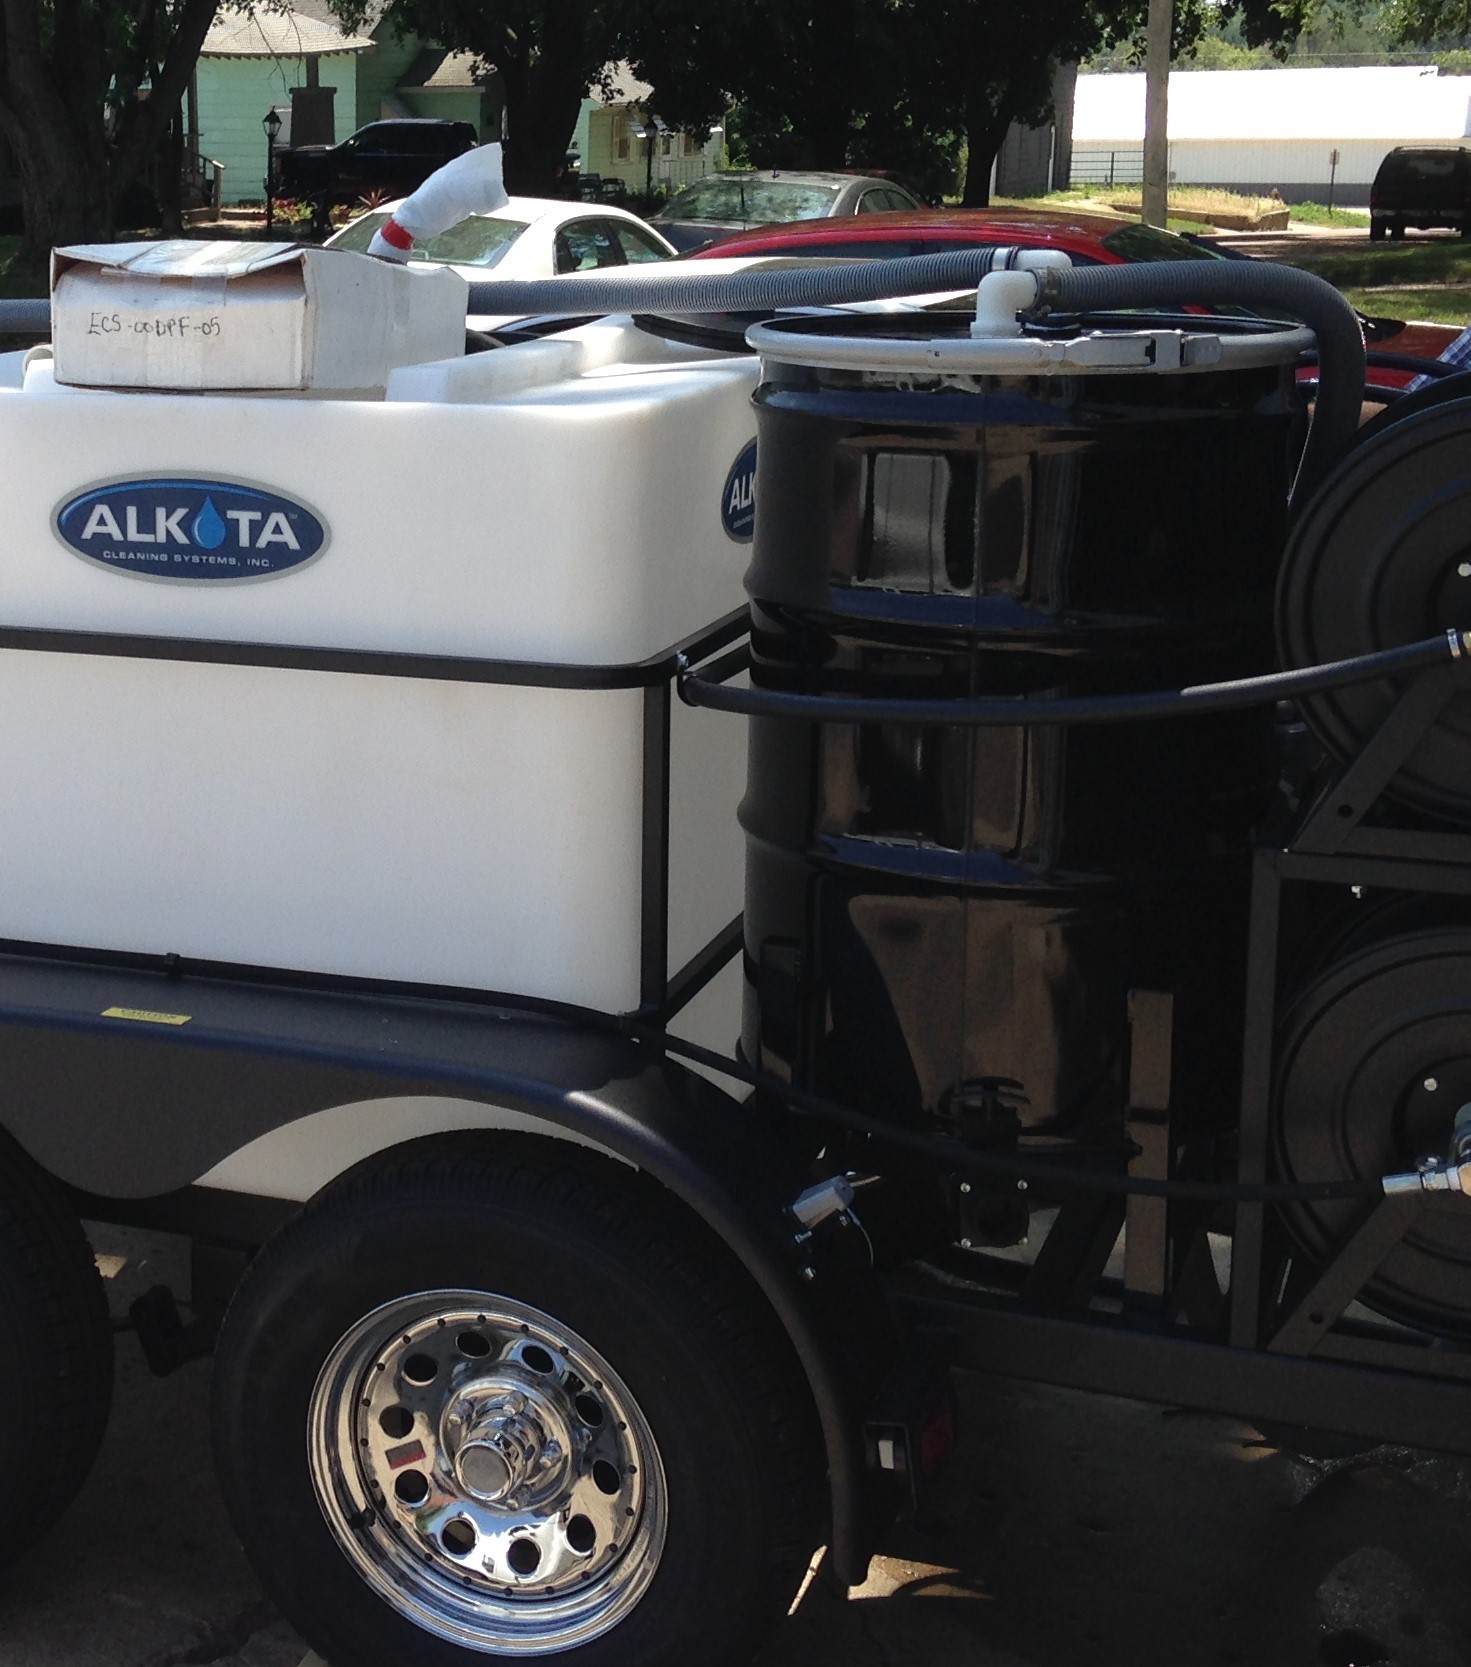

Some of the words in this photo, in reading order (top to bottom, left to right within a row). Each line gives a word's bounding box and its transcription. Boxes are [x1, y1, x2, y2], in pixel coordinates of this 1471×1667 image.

[81, 497, 301, 550] ALKOTA
[103, 550, 168, 562] CLEANING
[174, 554, 241, 566] SYSTEMS,
[247, 558, 274, 567] INC.
